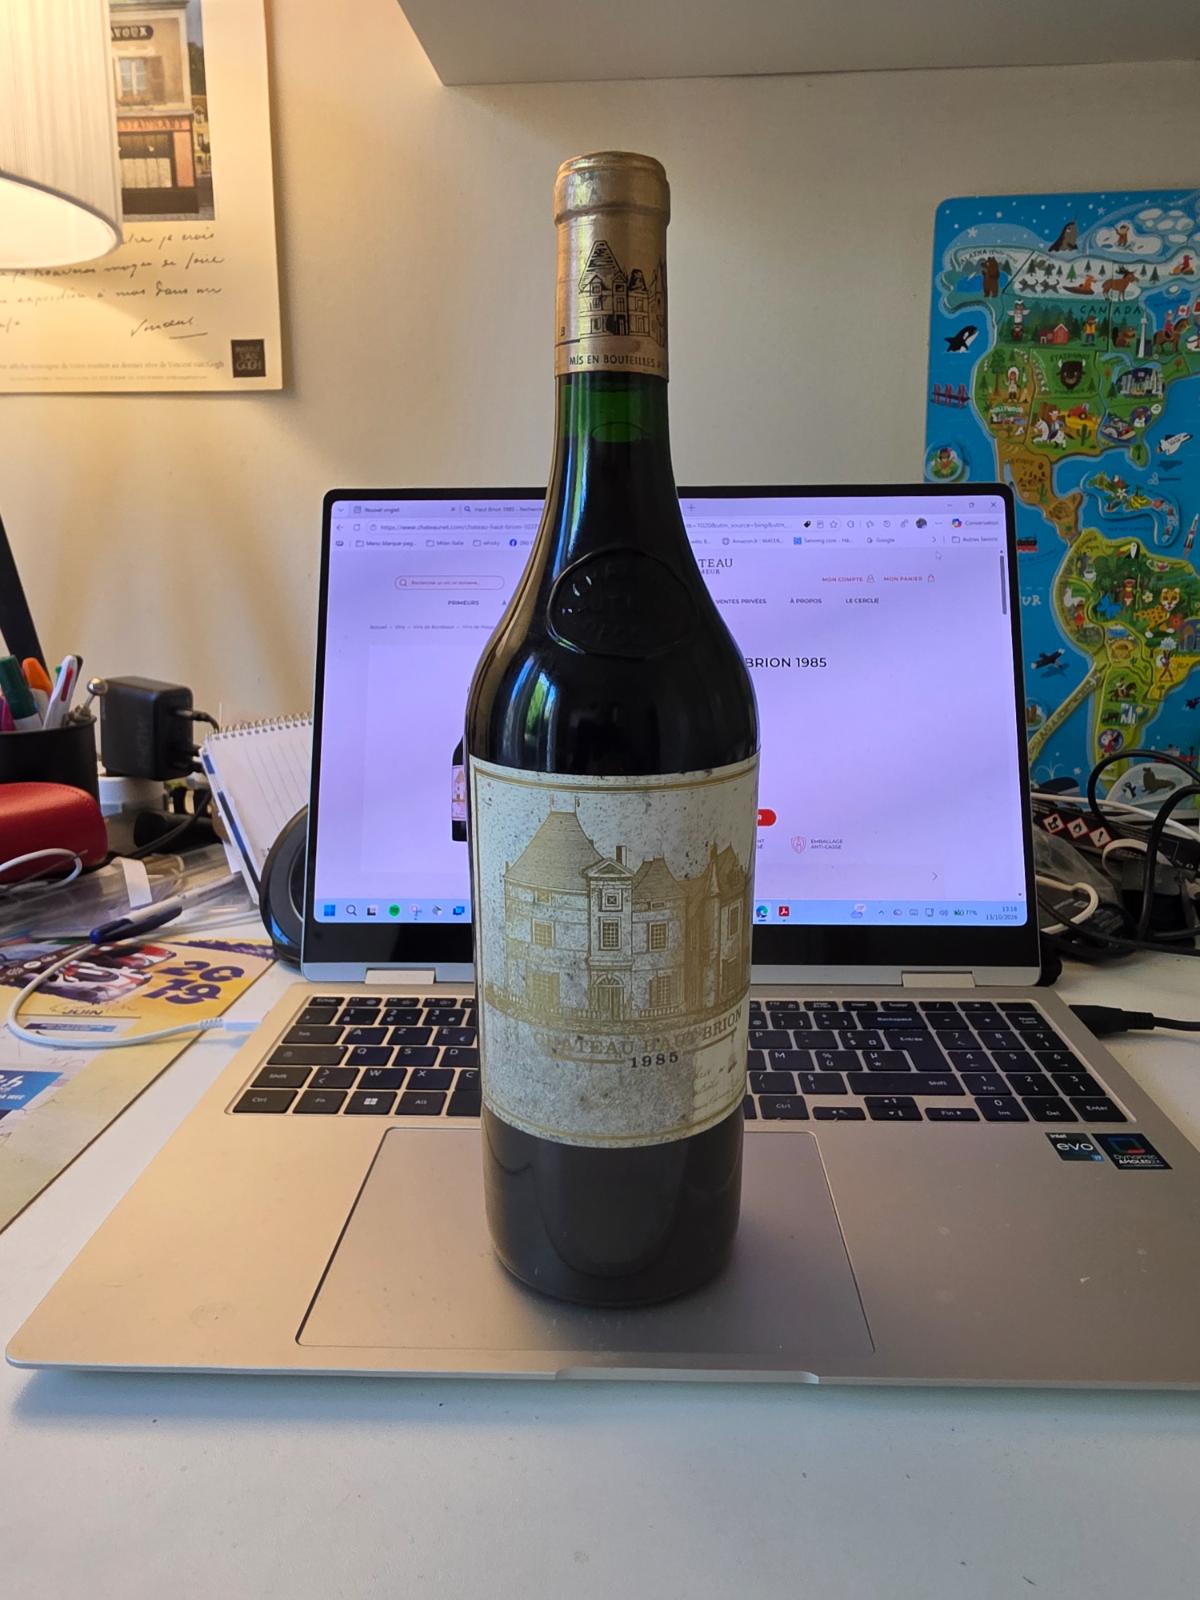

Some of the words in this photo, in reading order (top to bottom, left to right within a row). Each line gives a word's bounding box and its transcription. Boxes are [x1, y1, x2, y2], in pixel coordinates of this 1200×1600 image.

[1080, 305, 1142, 315] CANADA
[569, 355, 584, 365] MIS
[587, 355, 600, 364] EN
[603, 354, 655, 367] BOUTEILLES
[745, 657, 791, 668] BRION
[796, 657, 827, 668] 1985
[153, 960, 246, 983] 20
[142, 978, 221, 1005] 19
[702, 1004, 743, 1041] BRION
[630, 1051, 679, 1068] 1985
[1057, 1142, 1094, 1151] evo
